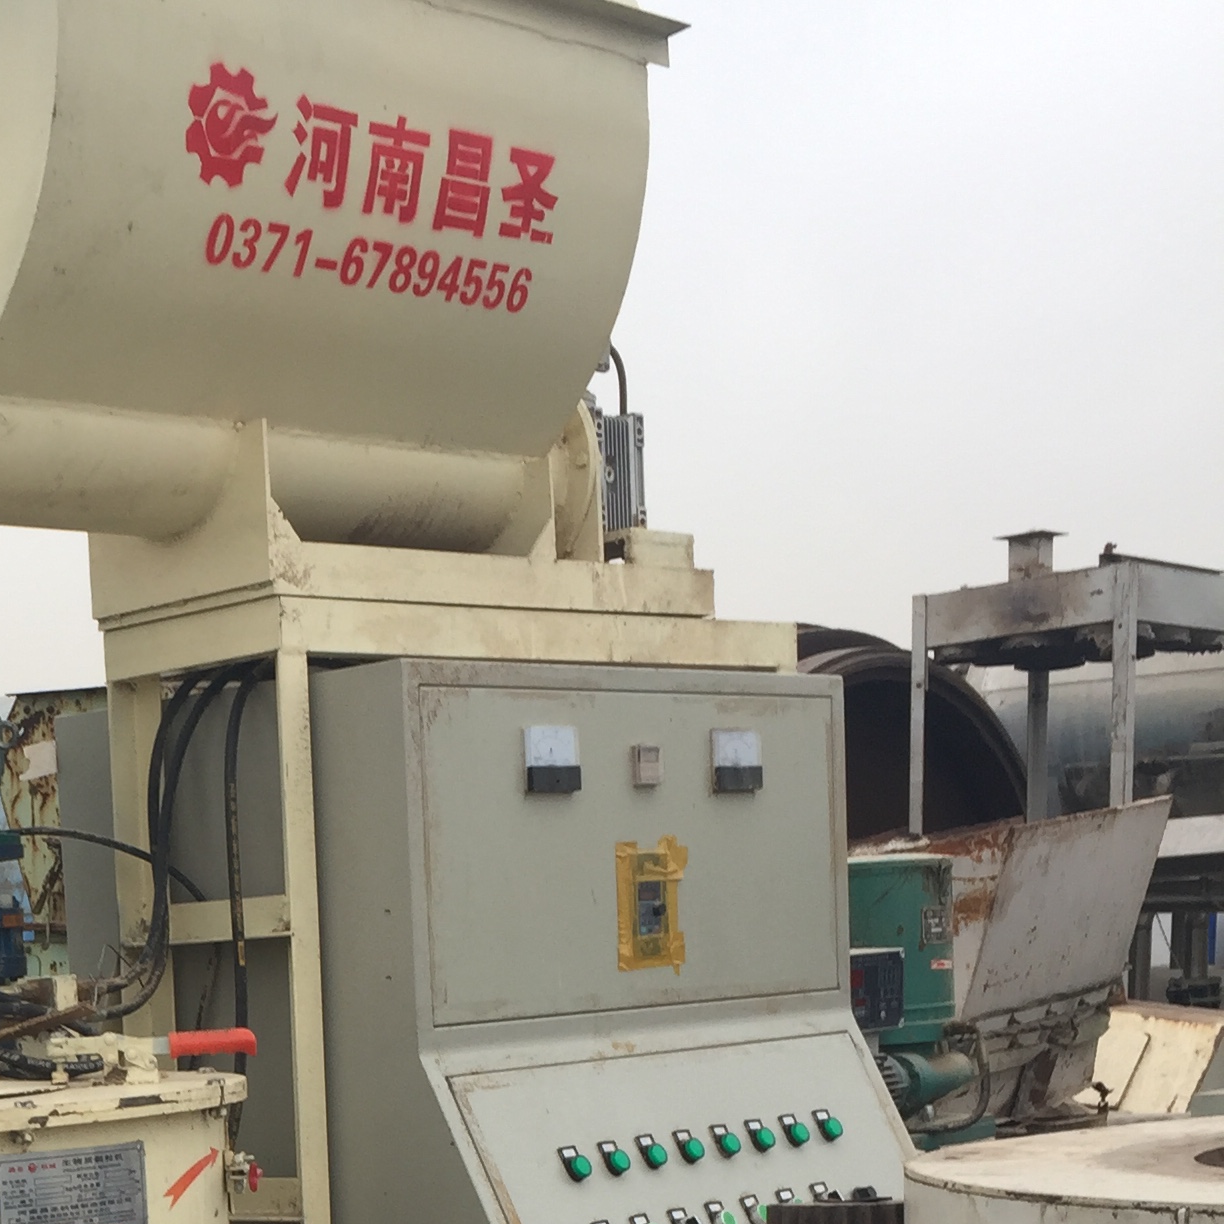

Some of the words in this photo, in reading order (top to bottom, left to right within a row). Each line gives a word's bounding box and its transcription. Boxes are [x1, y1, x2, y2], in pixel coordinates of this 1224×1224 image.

[284, 94, 559, 245] 河南昌圣
[205, 213, 533, 314] 0371-67894556
